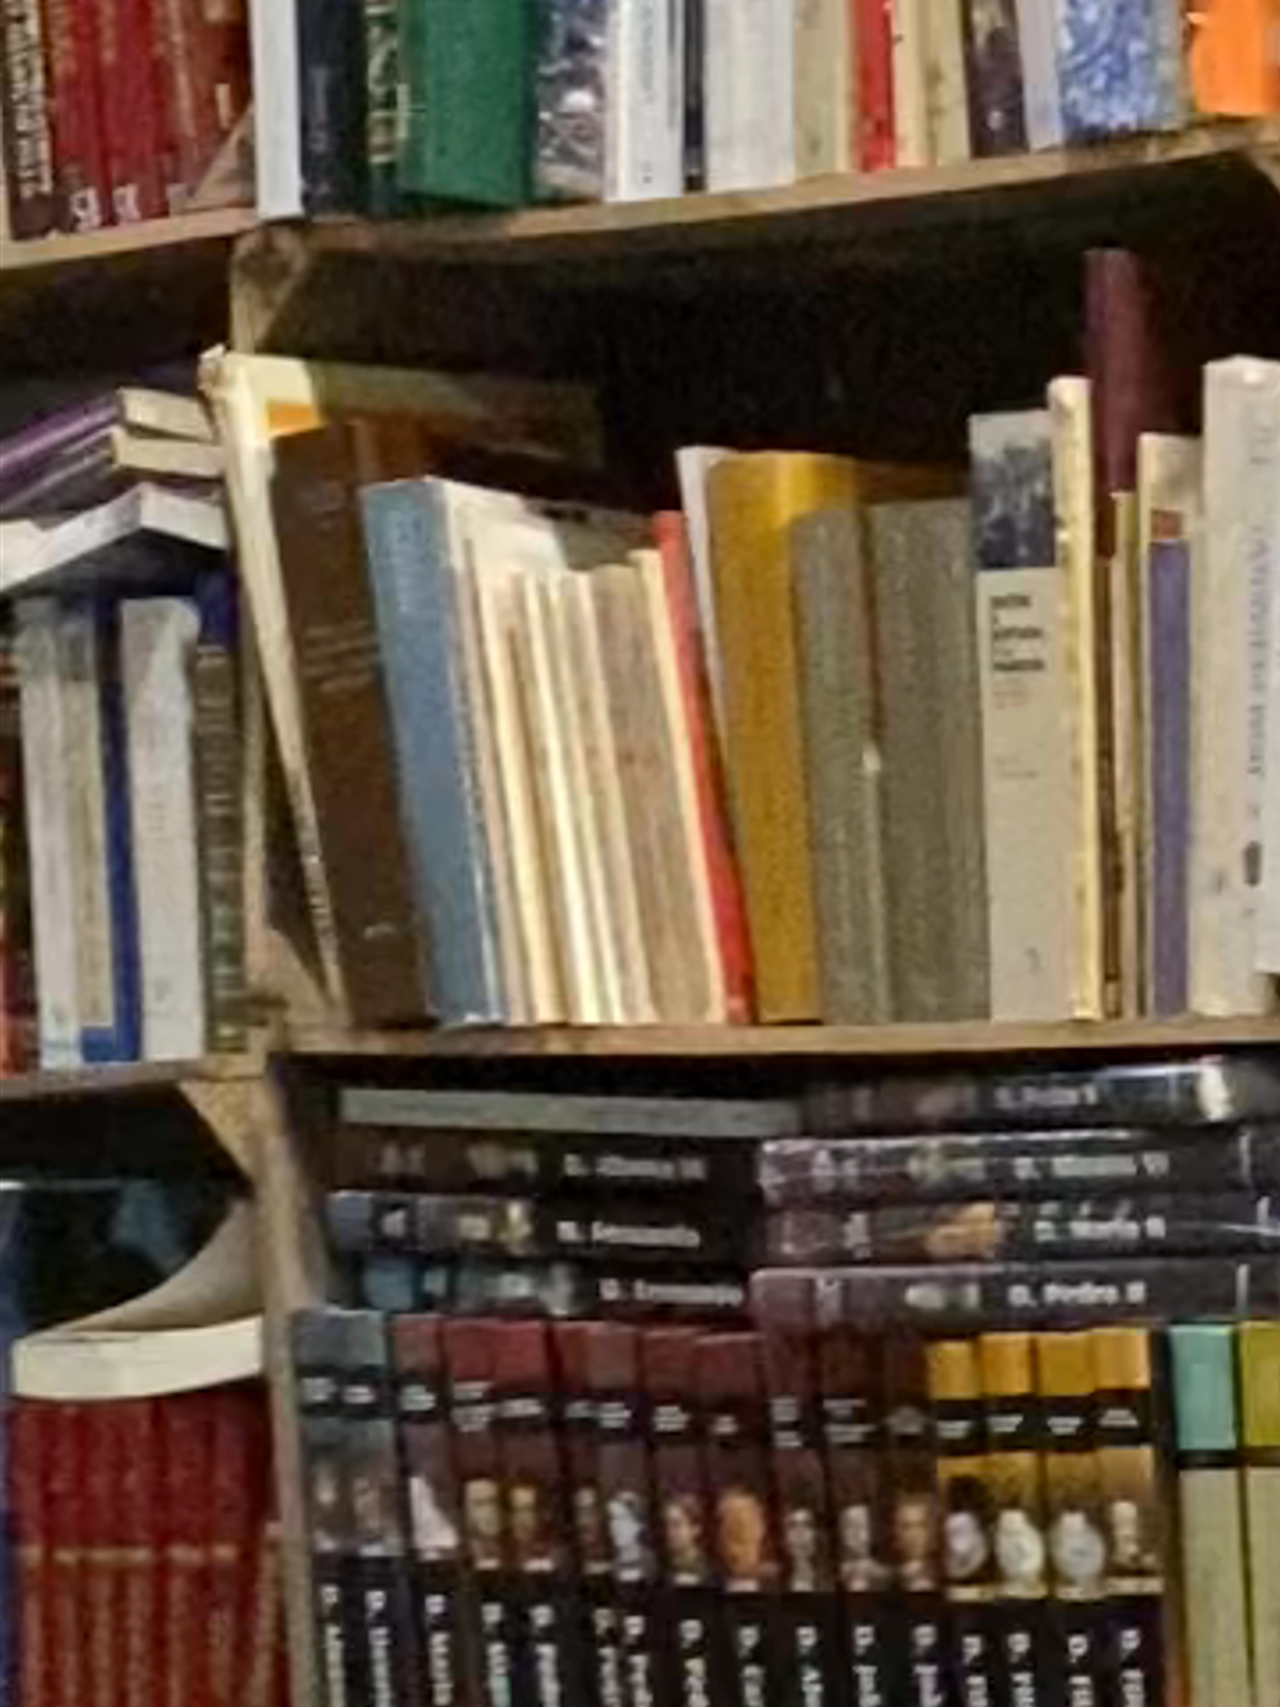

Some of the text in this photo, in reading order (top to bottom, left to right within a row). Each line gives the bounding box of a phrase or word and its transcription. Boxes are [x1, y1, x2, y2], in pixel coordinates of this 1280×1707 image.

[321, 1584, 340, 1611] D.
[365, 1590, 386, 1620] D.
[425, 1594, 446, 1620] D.
[481, 1602, 503, 1631] D.
[529, 1604, 555, 1634] D.
[595, 1607, 616, 1639] D.
[622, 1615, 645, 1643] D.
[679, 1618, 702, 1650] D.
[737, 1625, 760, 1658] D.
[795, 1625, 818, 1654] D.
[853, 1624, 876, 1656] D.
[912, 1624, 937, 1656] D.
[1007, 1632, 1031, 1662] D.
[1067, 1634, 1089, 1664] D.
[1119, 1628, 1141, 1660] D.
[961, 1635, 983, 1665] D.
[430, 1630, 454, 1707] Maria
